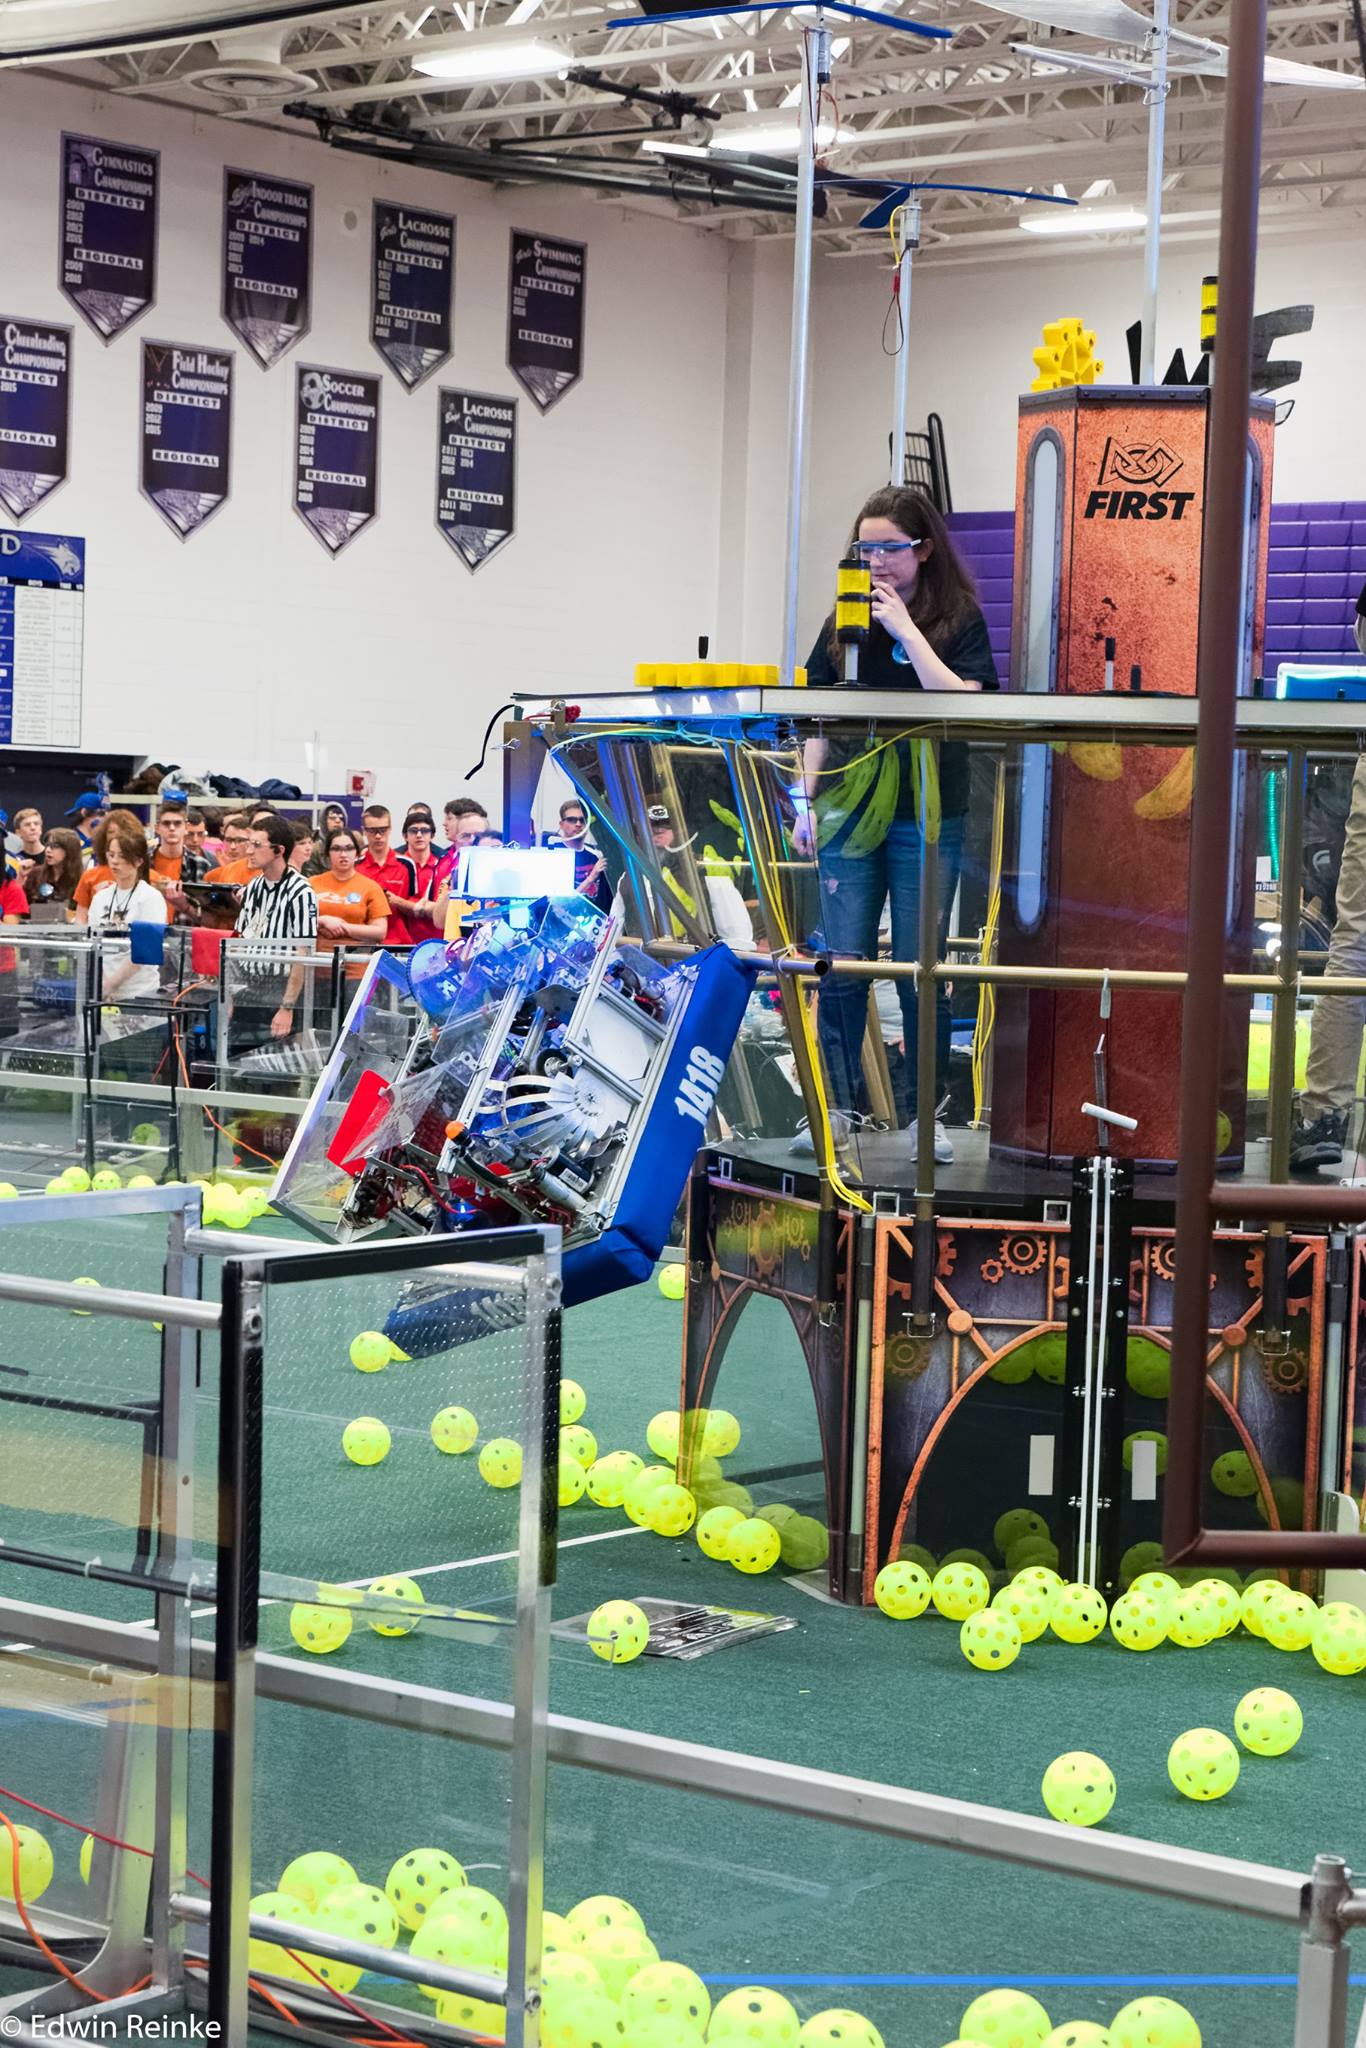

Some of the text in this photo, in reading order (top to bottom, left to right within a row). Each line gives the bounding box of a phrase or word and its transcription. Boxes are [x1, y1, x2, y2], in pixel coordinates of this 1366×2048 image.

[77, 188, 143, 210] DISTRICT
[237, 220, 299, 241] DISTRICT
[75, 249, 142, 270] REGIONAL
[385, 250, 441, 270] DISTRICT
[236, 278, 297, 299] REGIONAL
[521, 276, 574, 296] DISTRICT
[383, 305, 440, 324] REGIONAL
[519, 330, 572, 349] REGIONAL
[322, 373, 365, 398] SOCCER
[155, 391, 220, 409] DISTRICT
[461, 397, 513, 421] LACROSSE
[308, 414, 368, 431] DISTRICT
[450, 435, 504, 452] DISTRICT
[154, 450, 219, 467] REGIONAL
[306, 470, 366, 487] REGIONAL
[448, 489, 503, 506] REGIONAL
[1084, 491, 1195, 520] FIRST
[674, 1045, 725, 1127] 1418
